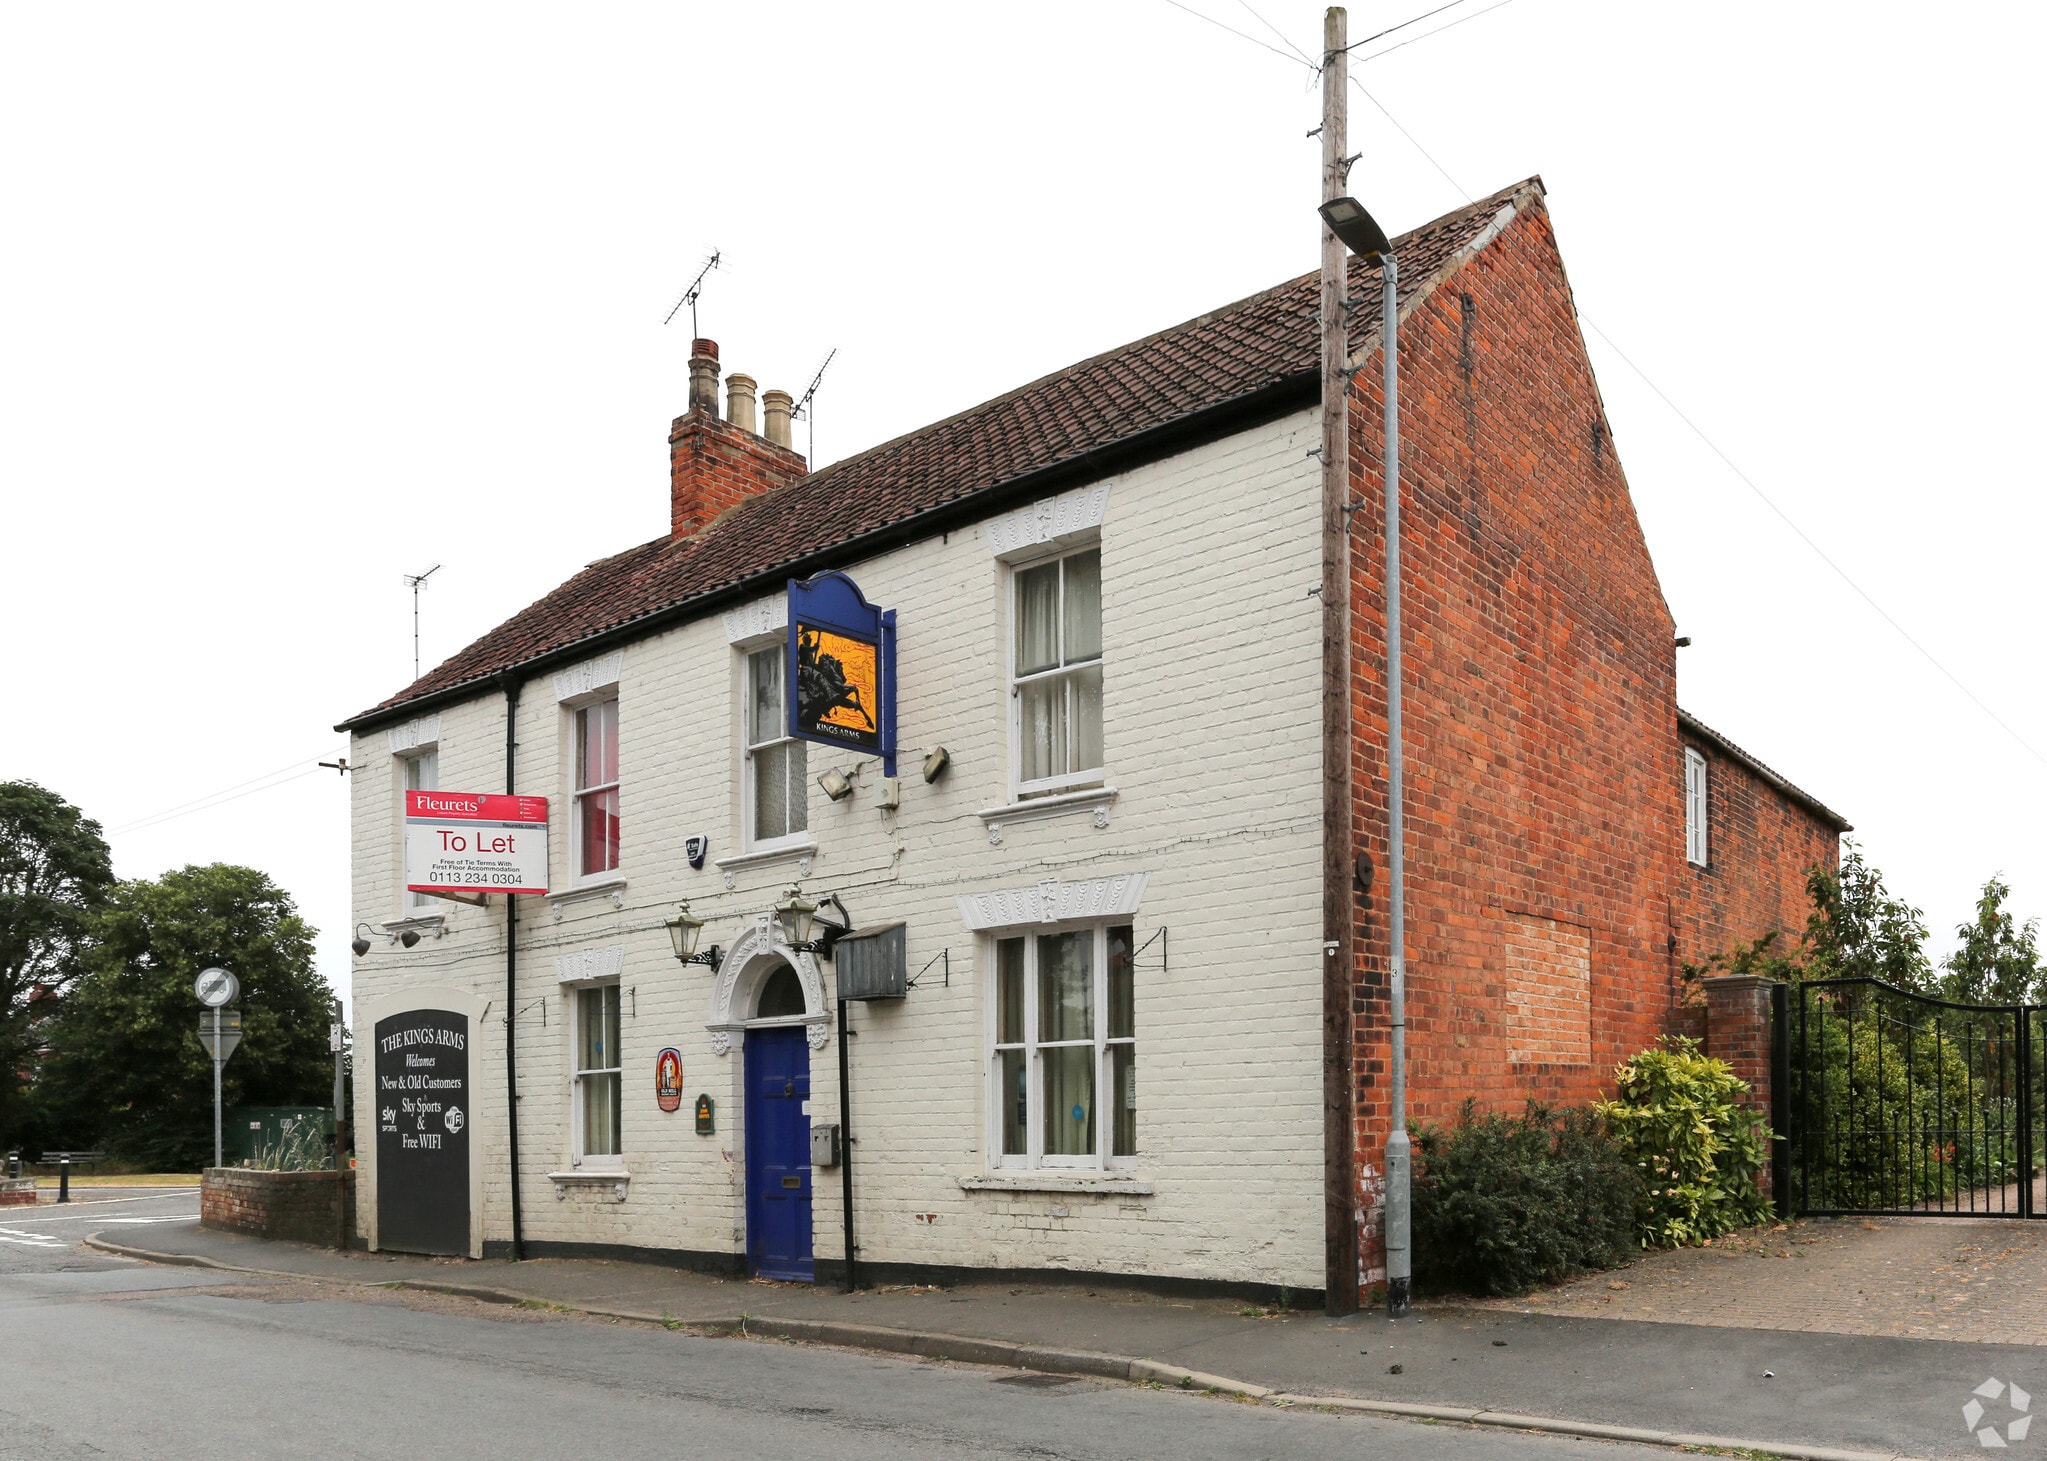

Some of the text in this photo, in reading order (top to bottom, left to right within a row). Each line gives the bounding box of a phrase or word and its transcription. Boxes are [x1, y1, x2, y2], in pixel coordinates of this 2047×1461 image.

[816, 722, 860, 739] KINGS ARMS
[416, 796, 478, 812] Fleurets
[436, 830, 515, 853] To Let
[467, 865, 520, 873] Accommodation
[429, 871, 523, 885] 0113 234 0304
[381, 1028, 465, 1054] THE KINGS ARMS
[405, 1053, 436, 1067] Welcomes
[381, 1074, 462, 1089] New & Old Customers
[382, 1106, 396, 1124] sky
[402, 1097, 442, 1117] Sky Sports
[417, 1115, 426, 1130] &
[402, 1133, 442, 1149] Free WIFI
